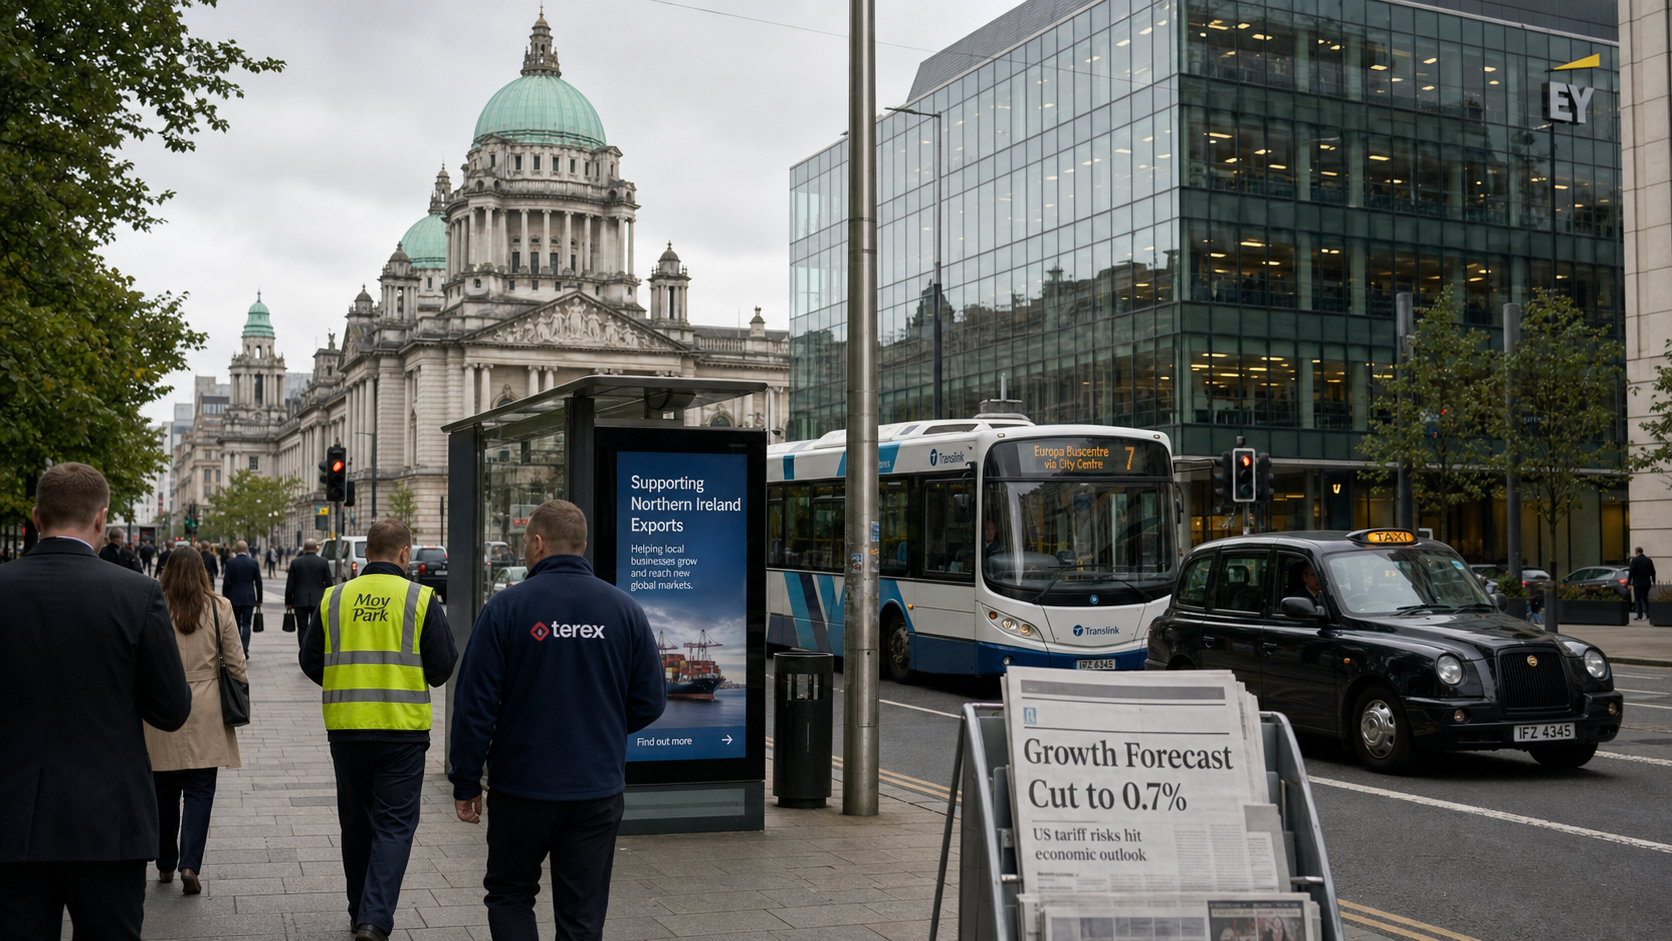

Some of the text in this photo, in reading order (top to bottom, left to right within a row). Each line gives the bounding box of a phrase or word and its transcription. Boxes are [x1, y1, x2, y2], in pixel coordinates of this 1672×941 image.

[1549, 81, 1595, 124] EY
[939, 451, 965, 464] Translink
[1034, 445, 1109, 459] Europa Buscentre
[1125, 446, 1135, 470] 7
[1044, 460, 1057, 469] via
[631, 475, 705, 493] Supporting
[631, 496, 741, 511] Northern Ireland
[631, 517, 684, 535] Exports
[1375, 532, 1408, 542] TAXI
[631, 544, 685, 556] Helping local
[630, 557, 698, 568] businesses grow
[630, 569, 691, 578] and reach new
[630, 581, 694, 592] global markets.
[353, 593, 391, 610] Moy
[353, 608, 389, 622] Park
[551, 620, 606, 639] terex
[1085, 626, 1119, 636] Translink
[1519, 725, 1571, 739] IFZ 4345
[636, 736, 693, 747] Find out more
[1024, 738, 1234, 770] Growth Forecast
[1028, 778, 1187, 812] Cut to 0.7%
[1033, 827, 1142, 842] US tariff risks hit
[1035, 847, 1147, 862] economic outlook
